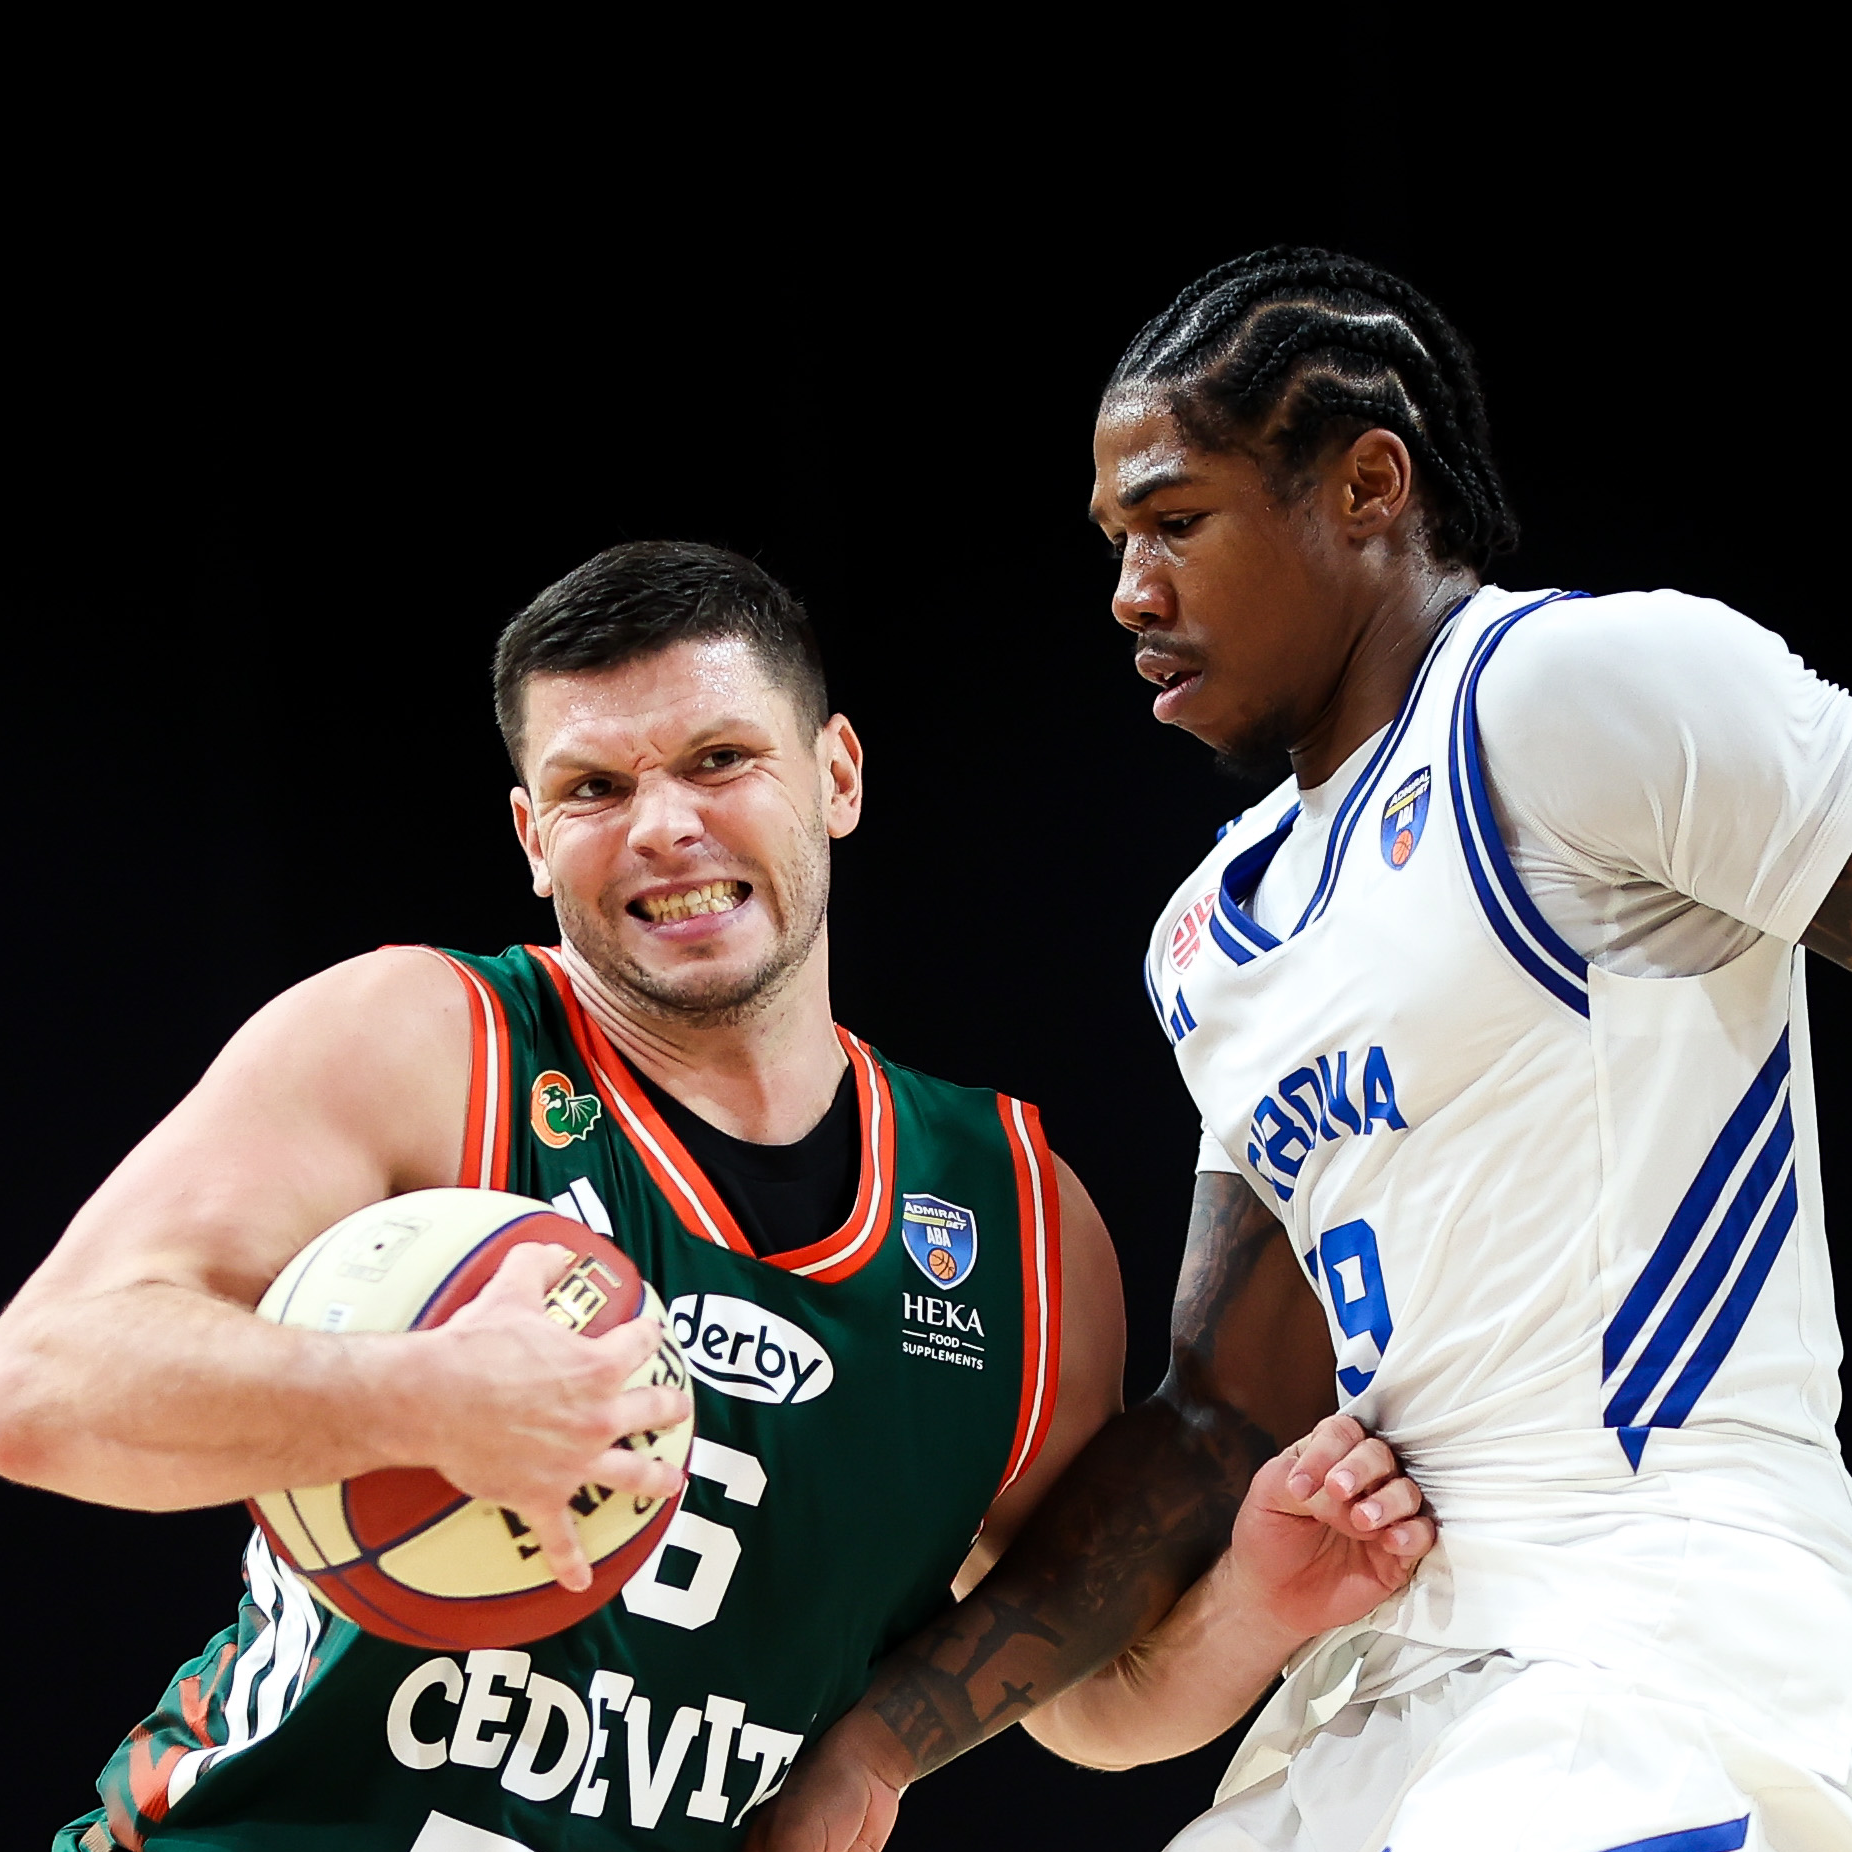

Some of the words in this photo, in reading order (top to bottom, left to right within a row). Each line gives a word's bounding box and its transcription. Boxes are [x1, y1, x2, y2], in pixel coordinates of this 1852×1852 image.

[904, 1202, 967, 1223] ADMIRAL
[945, 1220, 968, 1231] BET
[926, 1226, 952, 1248] ABA
[902, 1292, 985, 1338] HEKA
[673, 1294, 823, 1404] derby
[929, 1332, 960, 1348] FOOD
[902, 1341, 984, 1370] SUPPLEMENTS
[622, 1437, 768, 1631] 6
[386, 1648, 805, 1830] CEDEVIT
